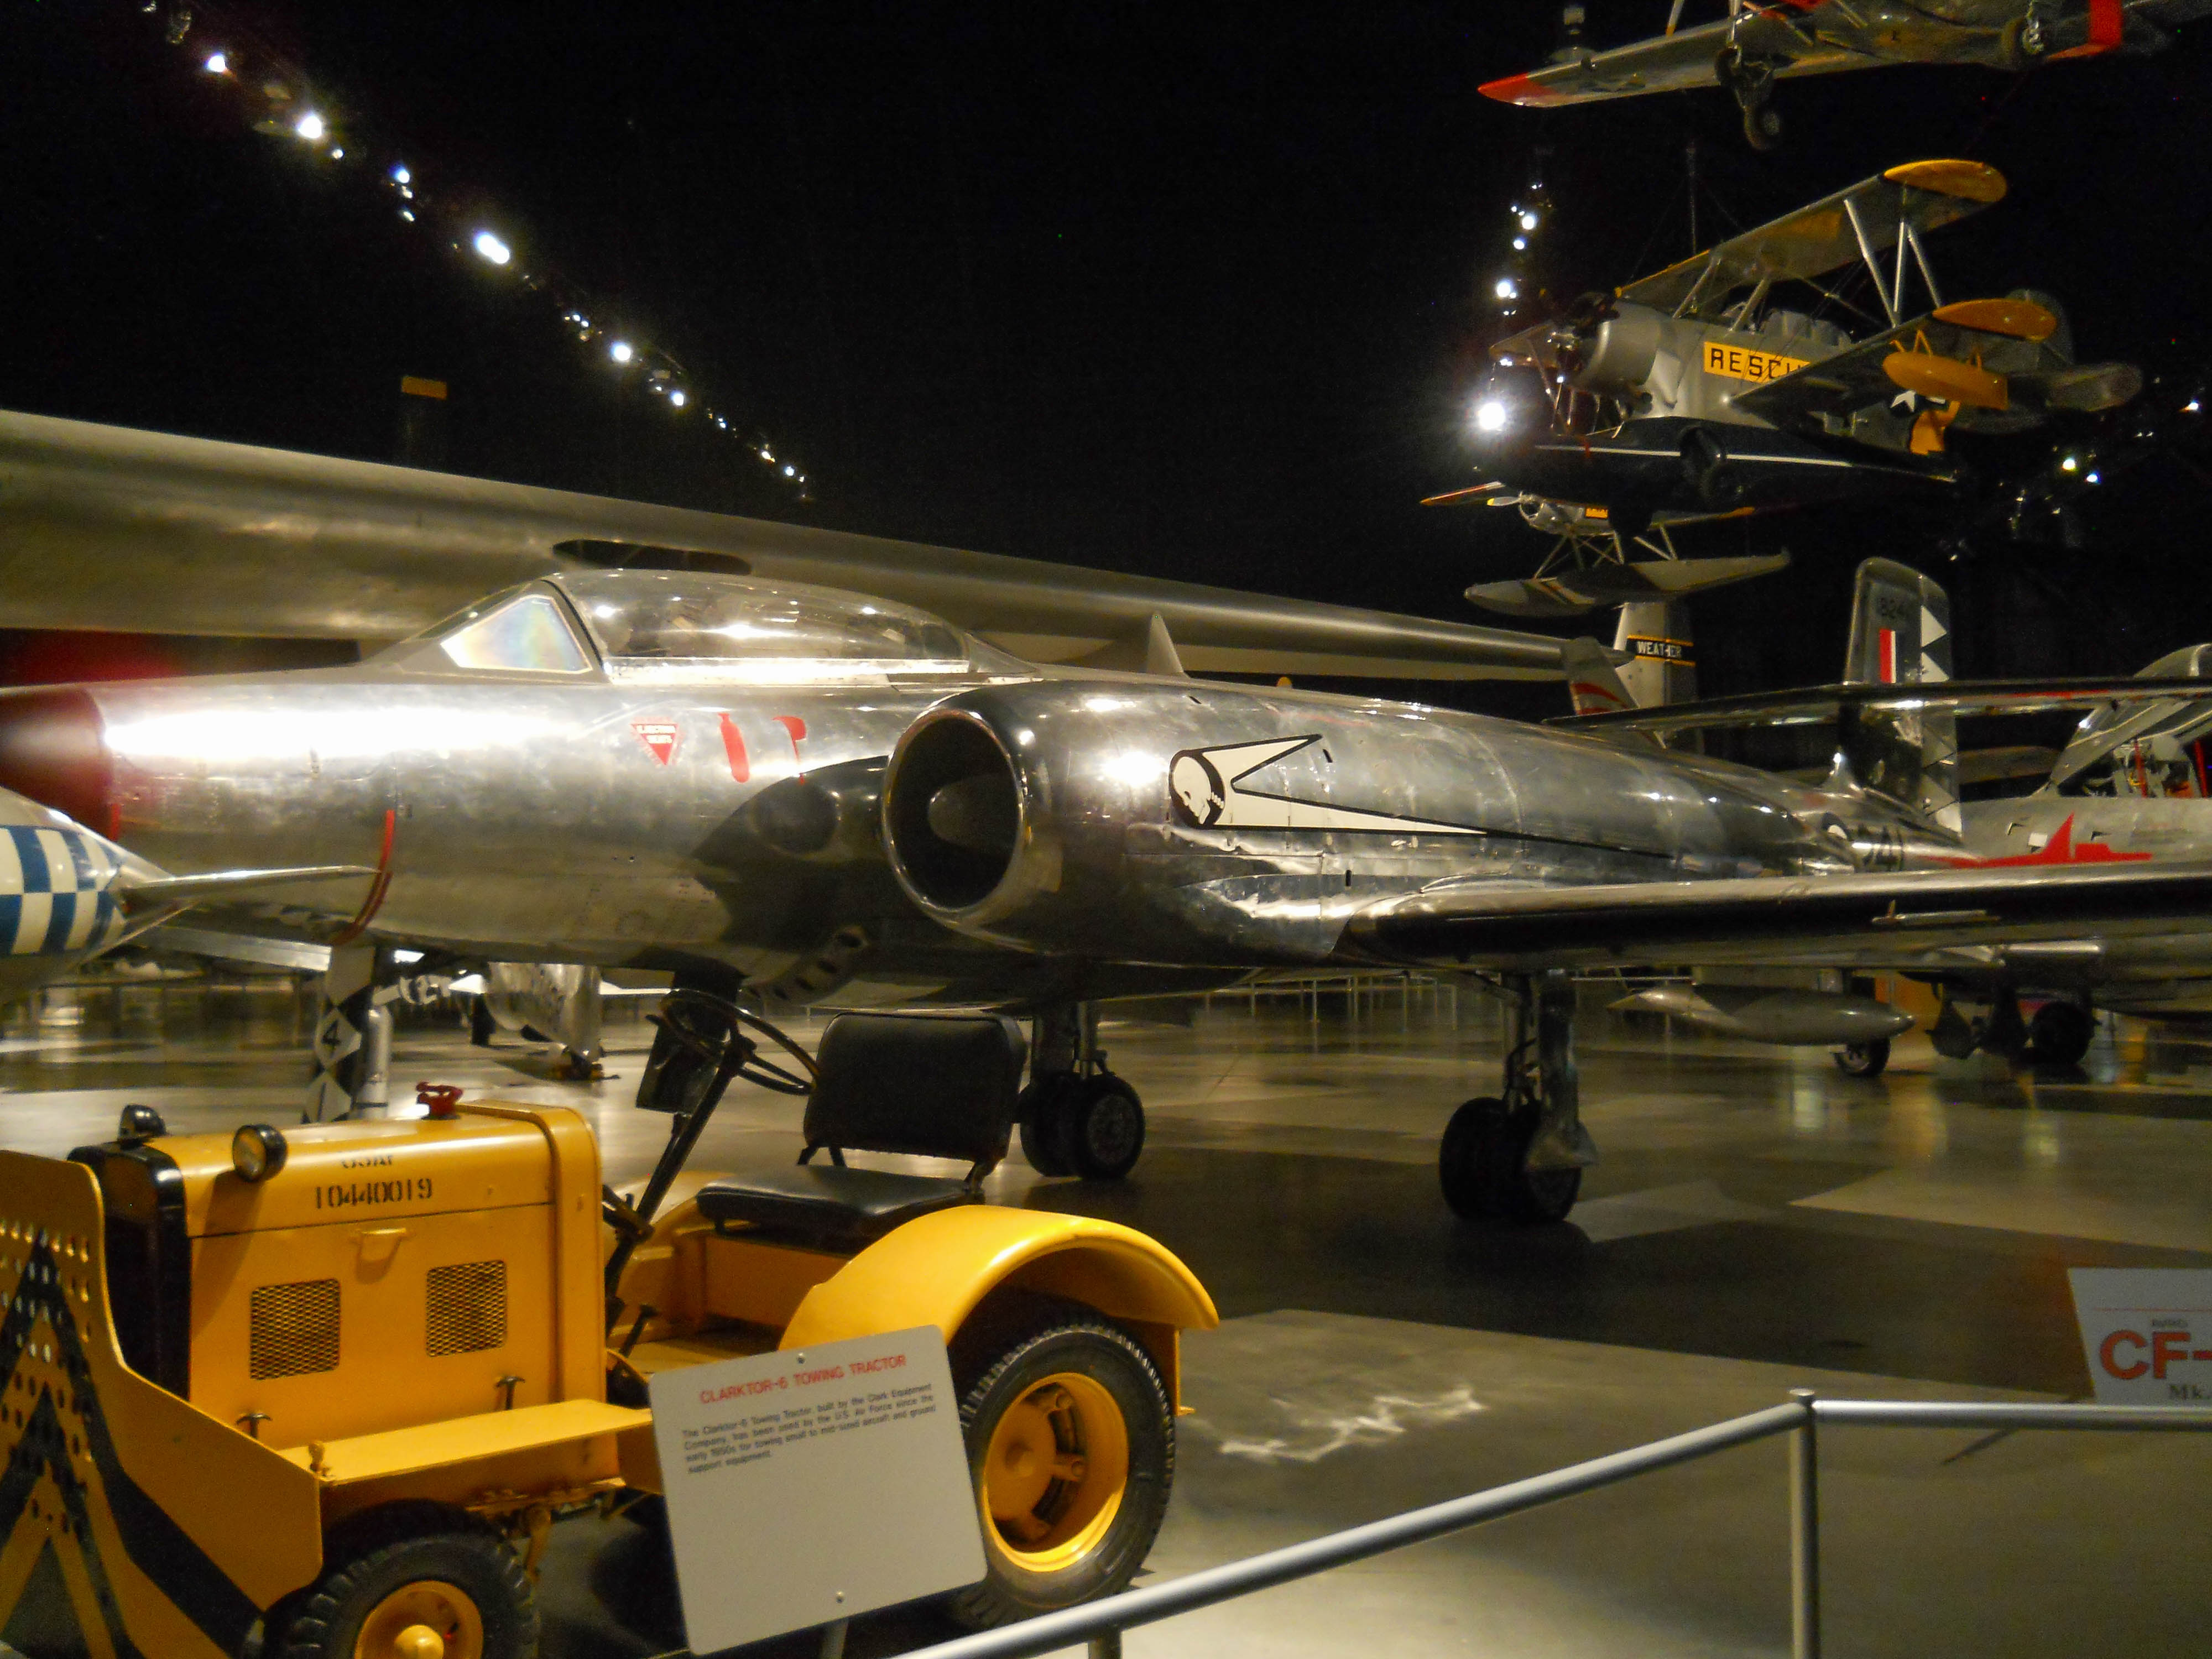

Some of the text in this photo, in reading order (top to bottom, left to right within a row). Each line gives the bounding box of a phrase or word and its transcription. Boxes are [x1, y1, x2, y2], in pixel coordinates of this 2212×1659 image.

[316, 1178, 432, 1209] 10440019
[2100, 1329, 2212, 1379] CF-
[700, 1354, 906, 1404] CLARKTOR-6 TOWING TRACTOR
[869, 1402, 891, 1412] Force
[682, 1428, 698, 1438] The
